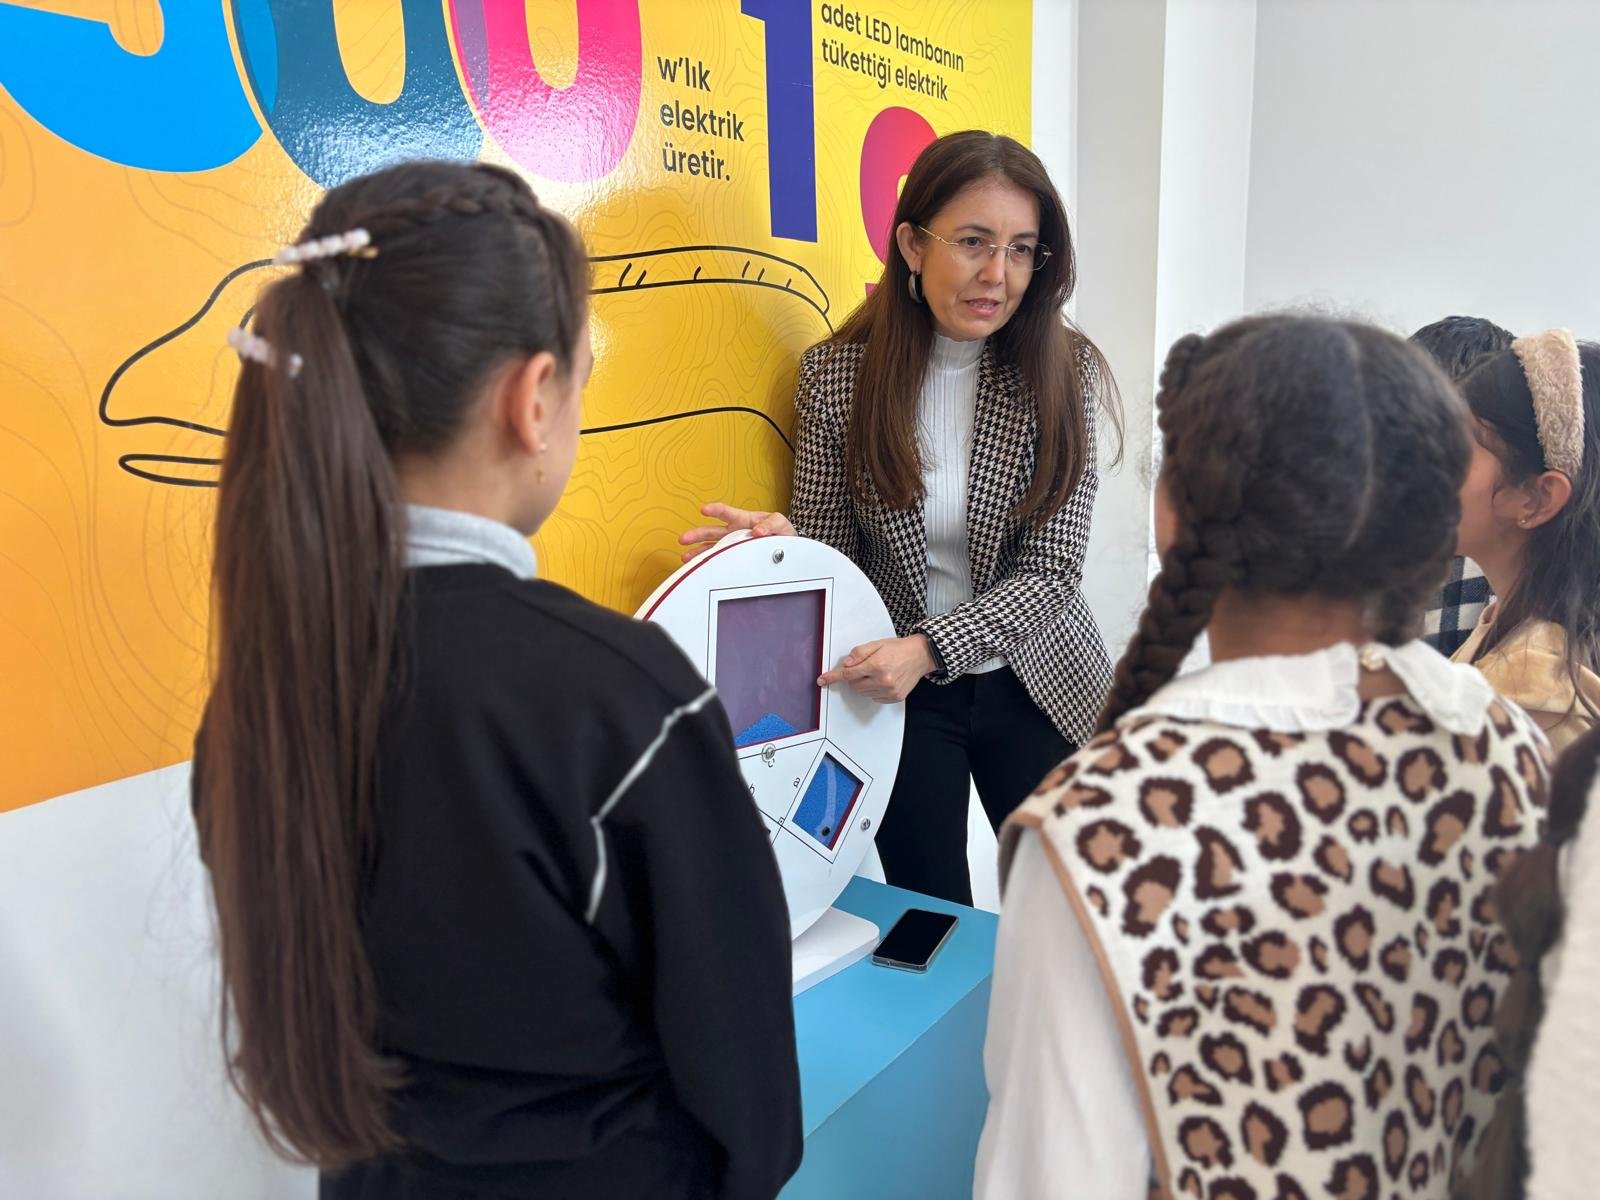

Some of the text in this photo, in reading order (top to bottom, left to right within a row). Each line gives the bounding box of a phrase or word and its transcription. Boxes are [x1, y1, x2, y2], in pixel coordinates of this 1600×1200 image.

[821, 3, 964, 73] adet LED lambanın
[821, 38, 948, 101] tükettiği elektrik
[660, 99, 745, 142] elektrik
[662, 141, 730, 181] üretir.
